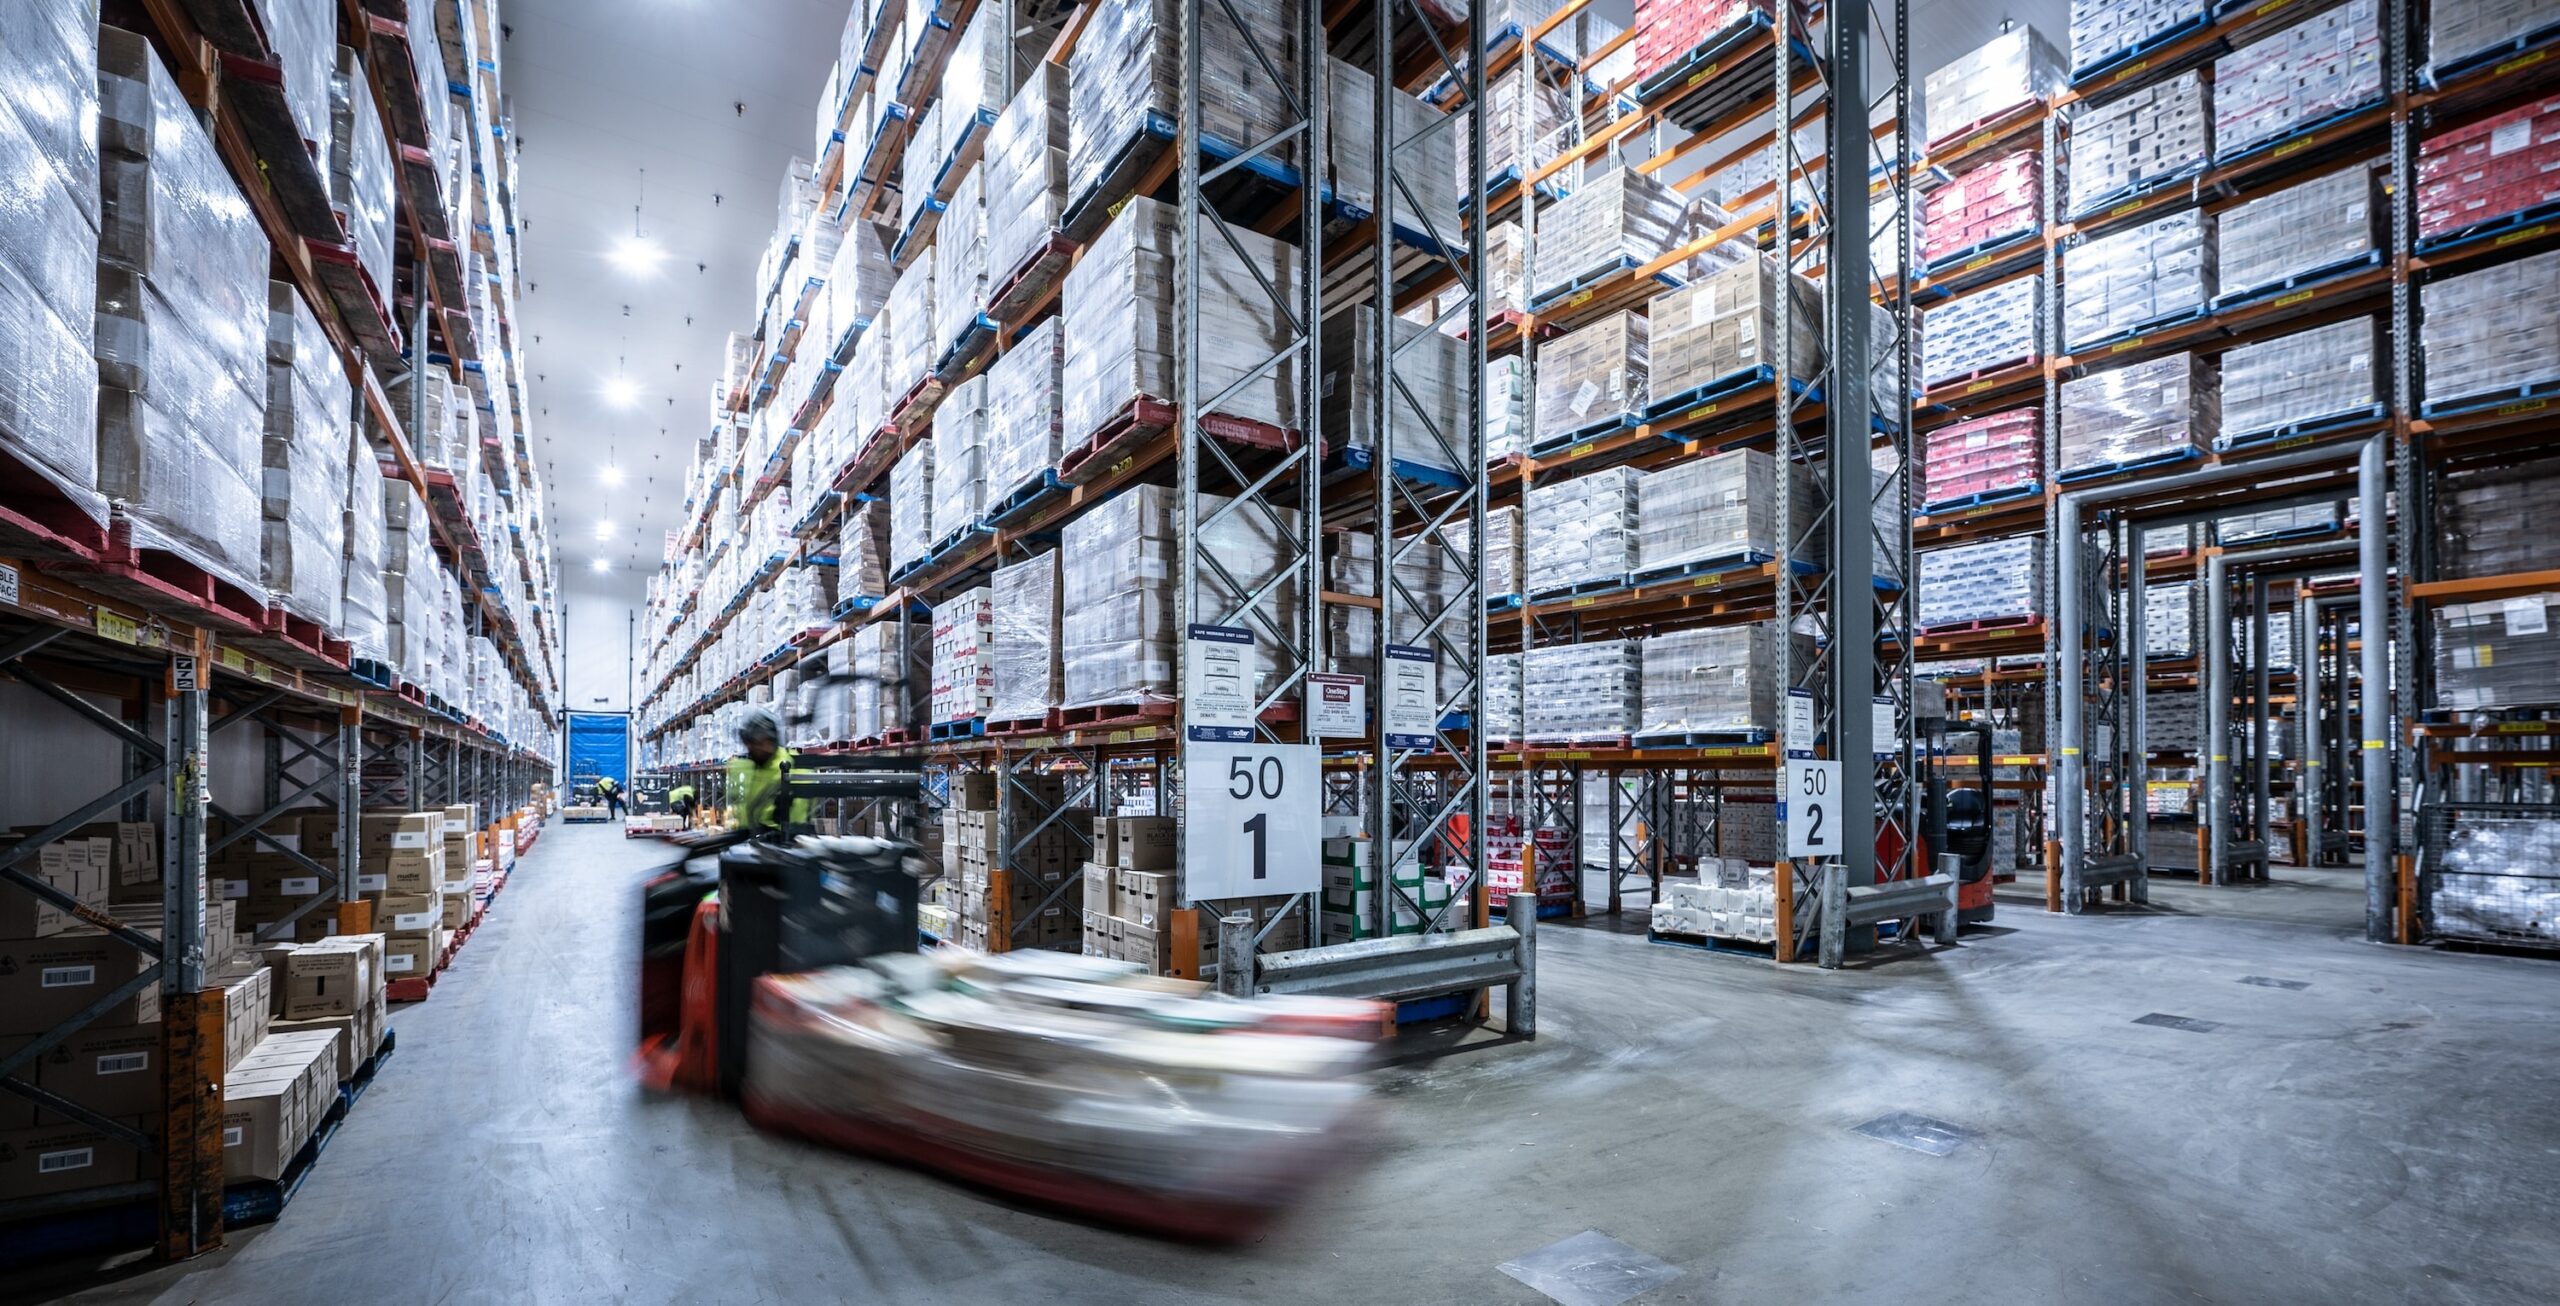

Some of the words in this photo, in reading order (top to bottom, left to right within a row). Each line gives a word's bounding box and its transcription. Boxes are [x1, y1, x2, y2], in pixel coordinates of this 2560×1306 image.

[1325, 687, 1348, 696] OneStop
[1229, 756, 1284, 800] 50
[1804, 768, 1826, 796] 50
[1807, 803, 1824, 846] 2
[1243, 813, 1267, 880] 1
